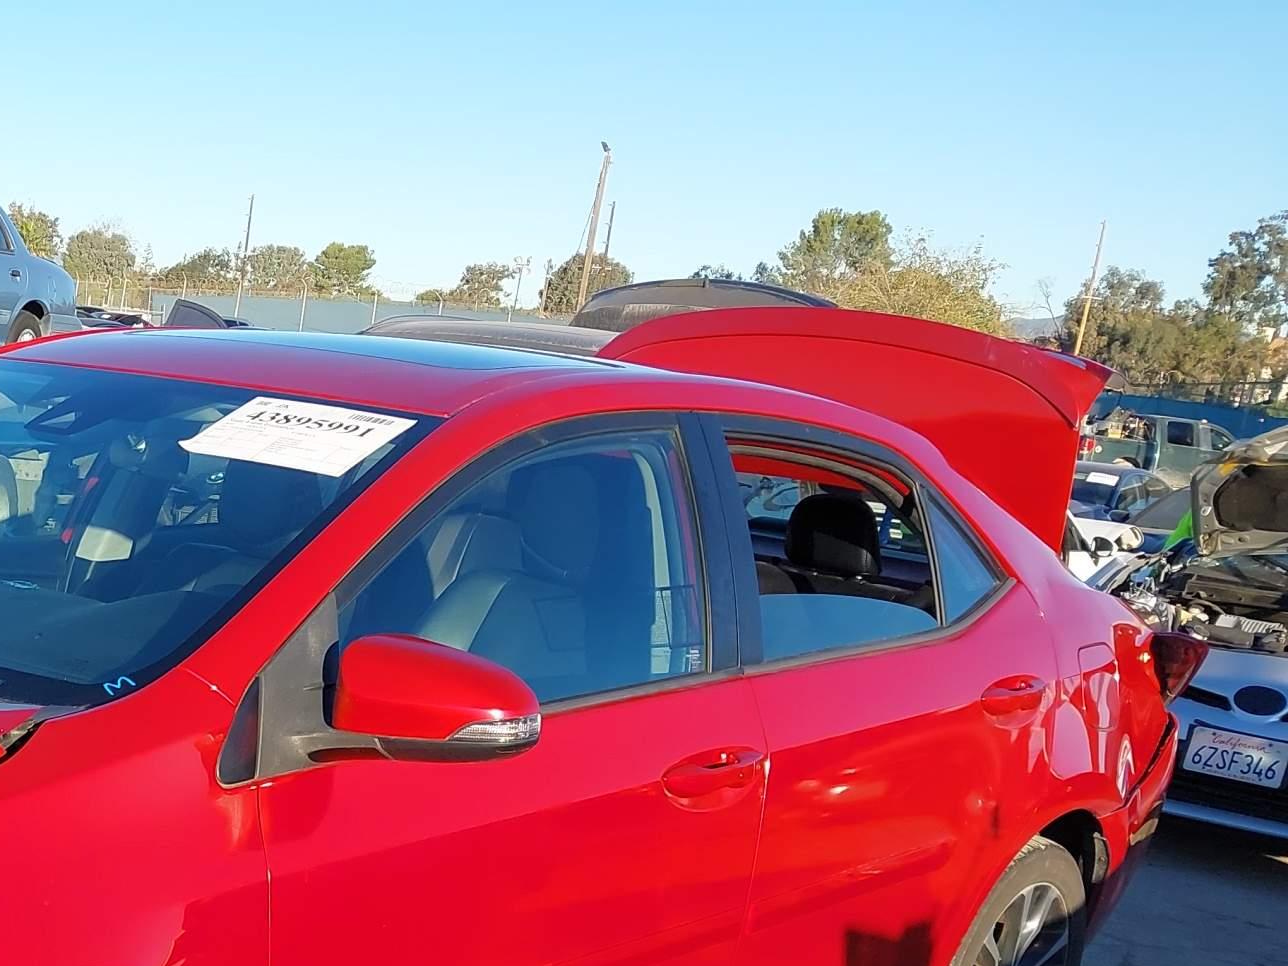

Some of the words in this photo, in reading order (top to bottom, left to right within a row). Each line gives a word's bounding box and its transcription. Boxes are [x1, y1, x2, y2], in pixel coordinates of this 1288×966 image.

[246, 410, 375, 438] 43895991
[1212, 734, 1272, 754] California
[1192, 745, 1280, 780] 6ZSF346
